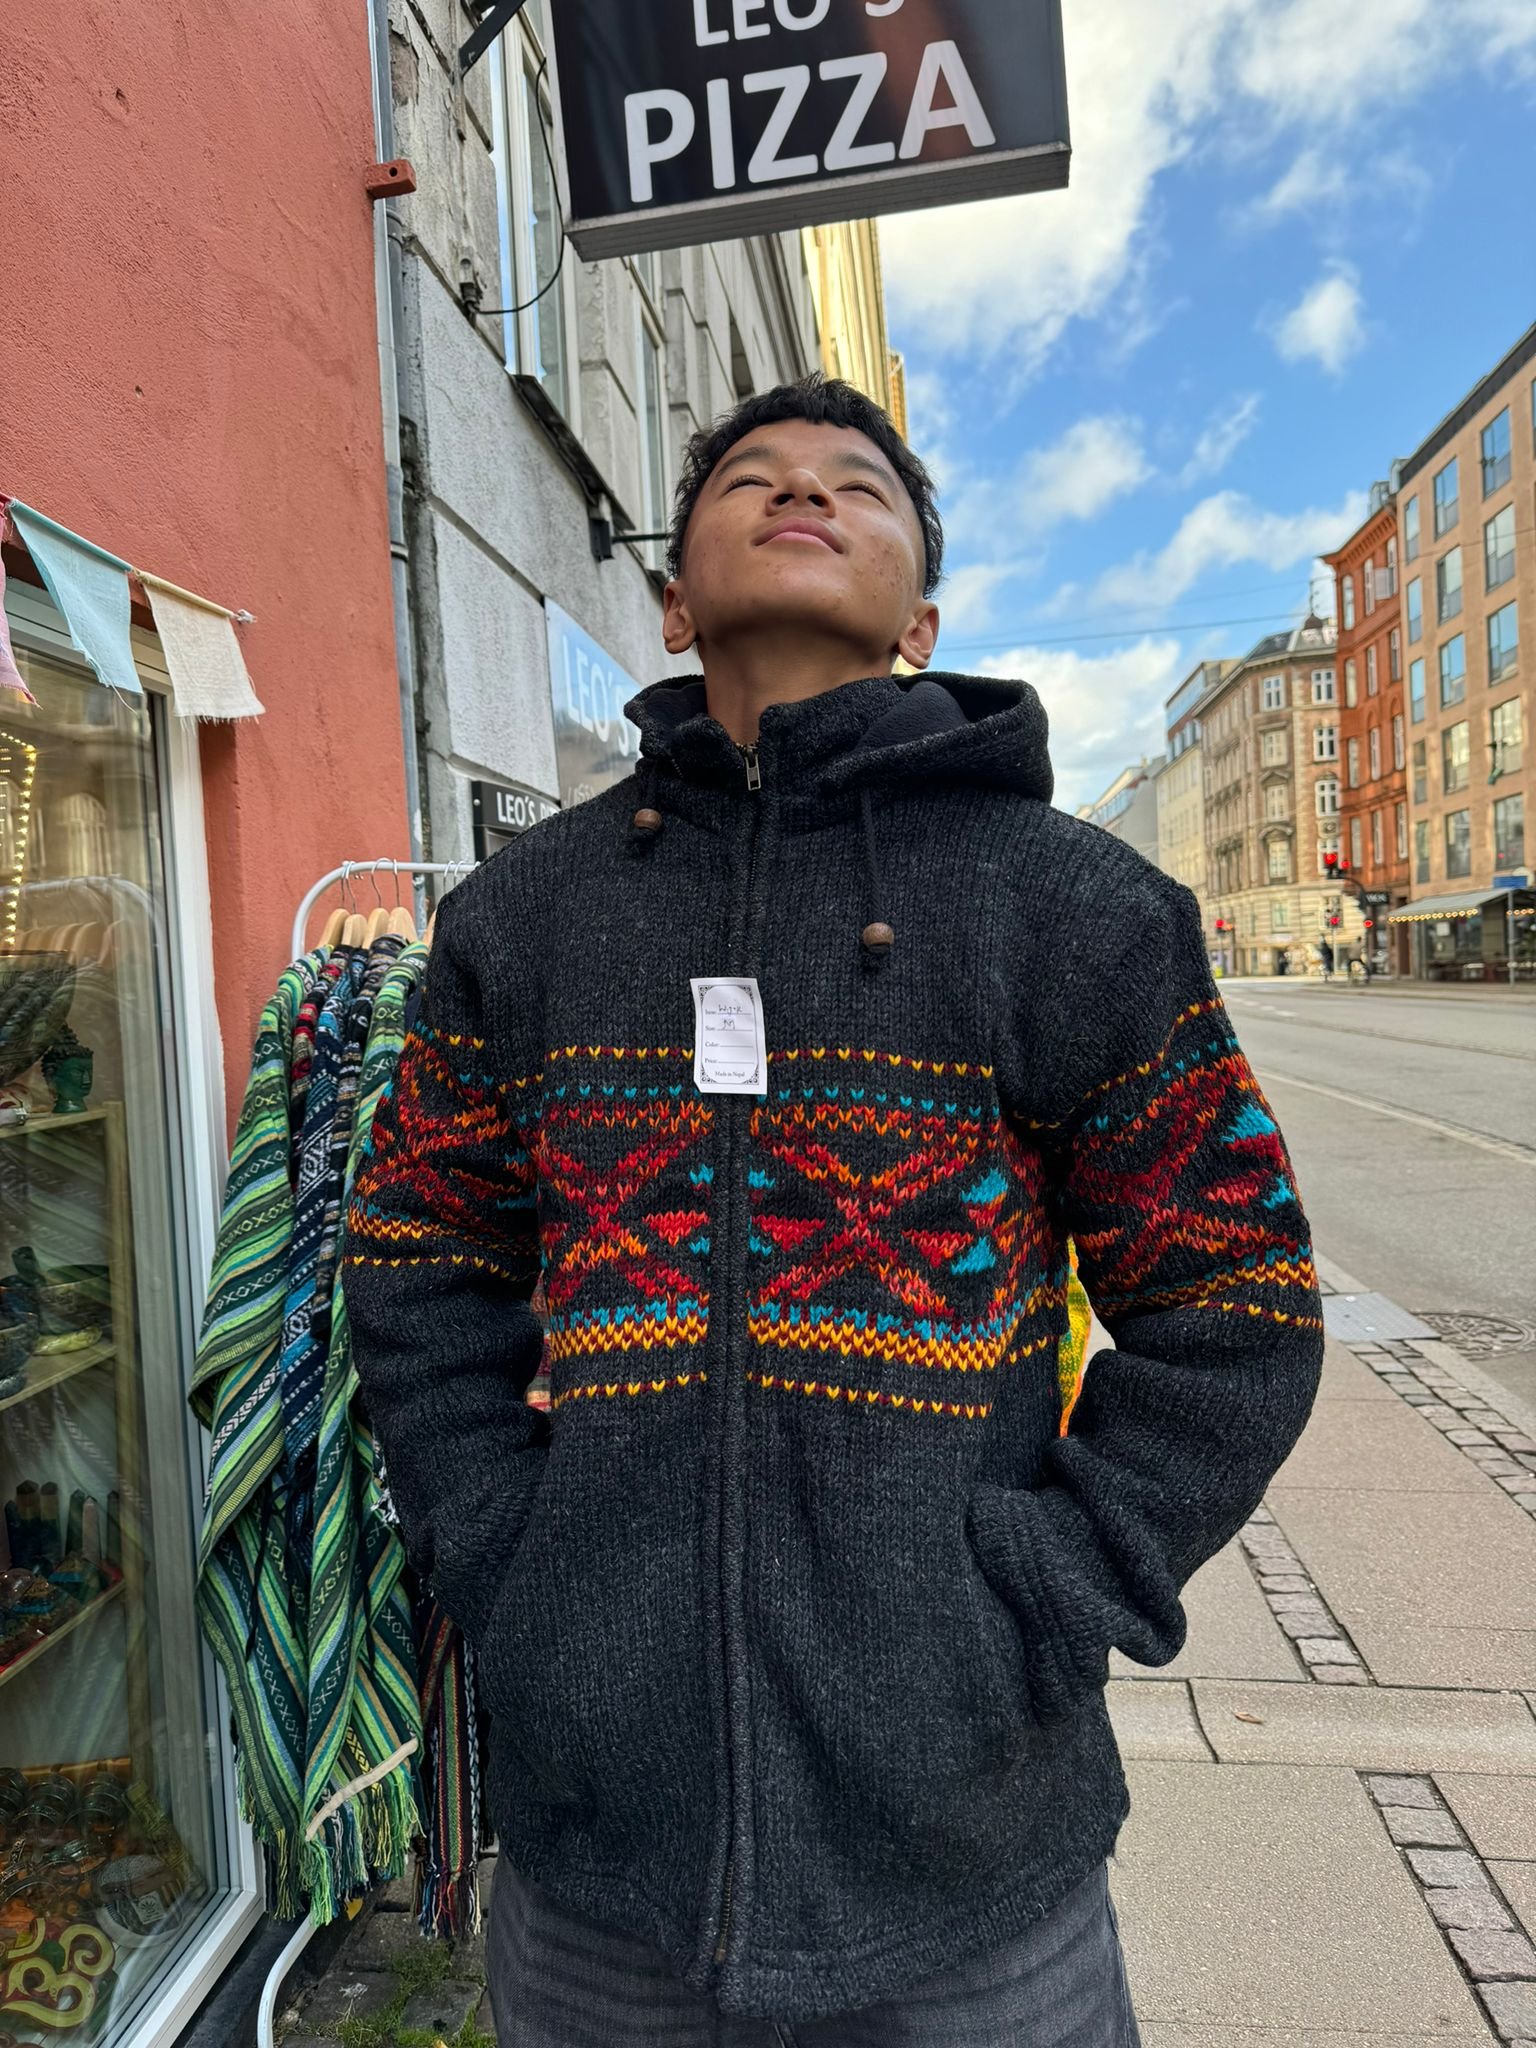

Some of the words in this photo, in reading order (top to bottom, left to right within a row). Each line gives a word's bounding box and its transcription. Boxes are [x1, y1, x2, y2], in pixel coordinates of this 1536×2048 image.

[624, 40, 996, 203] PIZZA
[562, 634, 629, 757] LEO'S
[496, 791, 537, 827] LEO'S
